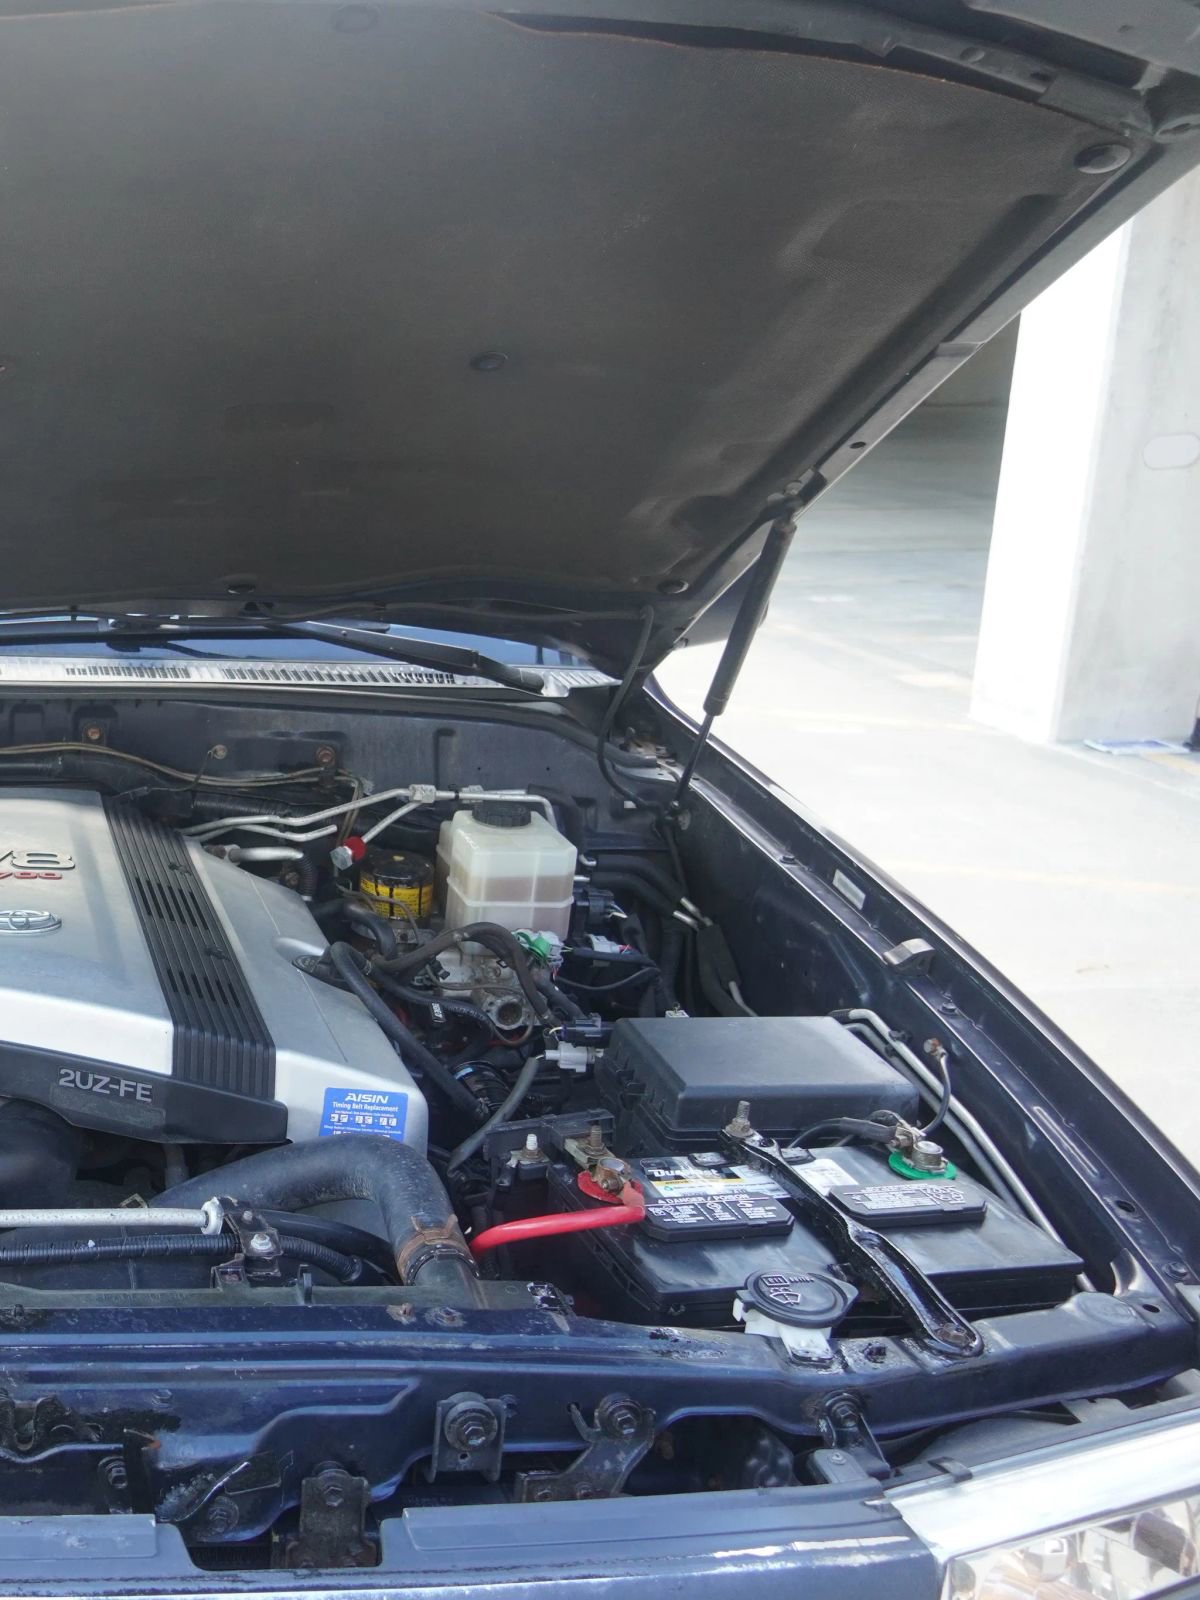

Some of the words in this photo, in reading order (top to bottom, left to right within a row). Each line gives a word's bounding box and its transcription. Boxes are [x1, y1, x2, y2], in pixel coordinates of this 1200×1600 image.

[58, 1068, 153, 1103] 2UZ-FE
[345, 1092, 389, 1104] AISIN
[333, 1101, 351, 1110] Timing
[352, 1102, 363, 1110] Belt
[364, 1104, 399, 1112] Replacement
